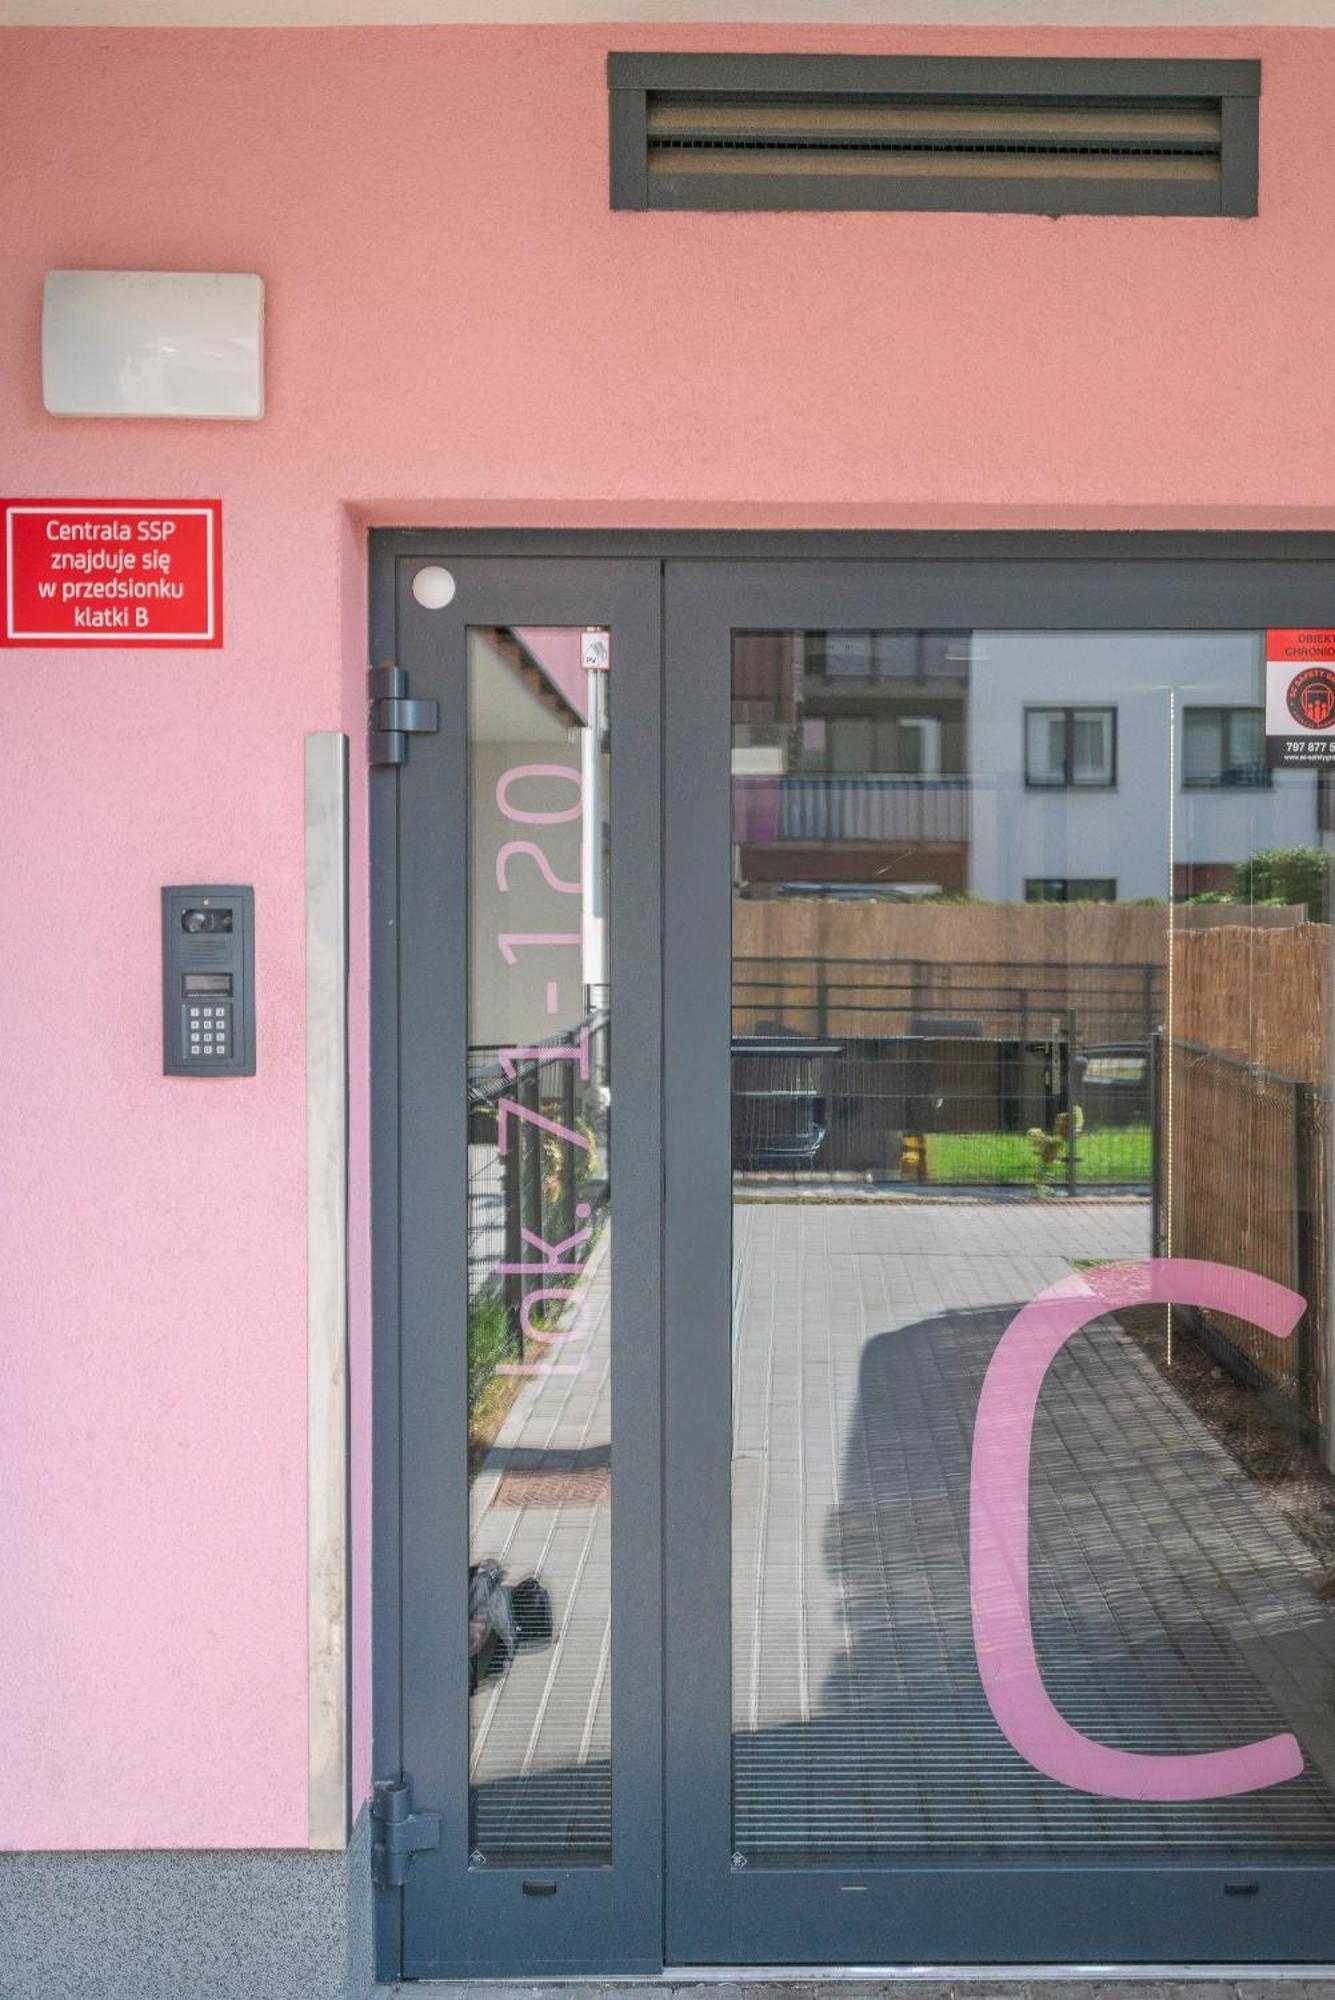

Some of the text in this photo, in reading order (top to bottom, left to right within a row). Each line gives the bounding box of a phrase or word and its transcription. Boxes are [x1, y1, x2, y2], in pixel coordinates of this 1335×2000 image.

[46, 520, 175, 541] Centrala SSP
[51, 549, 170, 574] znajduje się
[38, 578, 184, 602] w przedsionku
[74, 606, 149, 627] klatki B
[1286, 742, 1305, 752] 797
[1307, 742, 1327, 752] 877
[969, 1258, 1308, 1801] C
